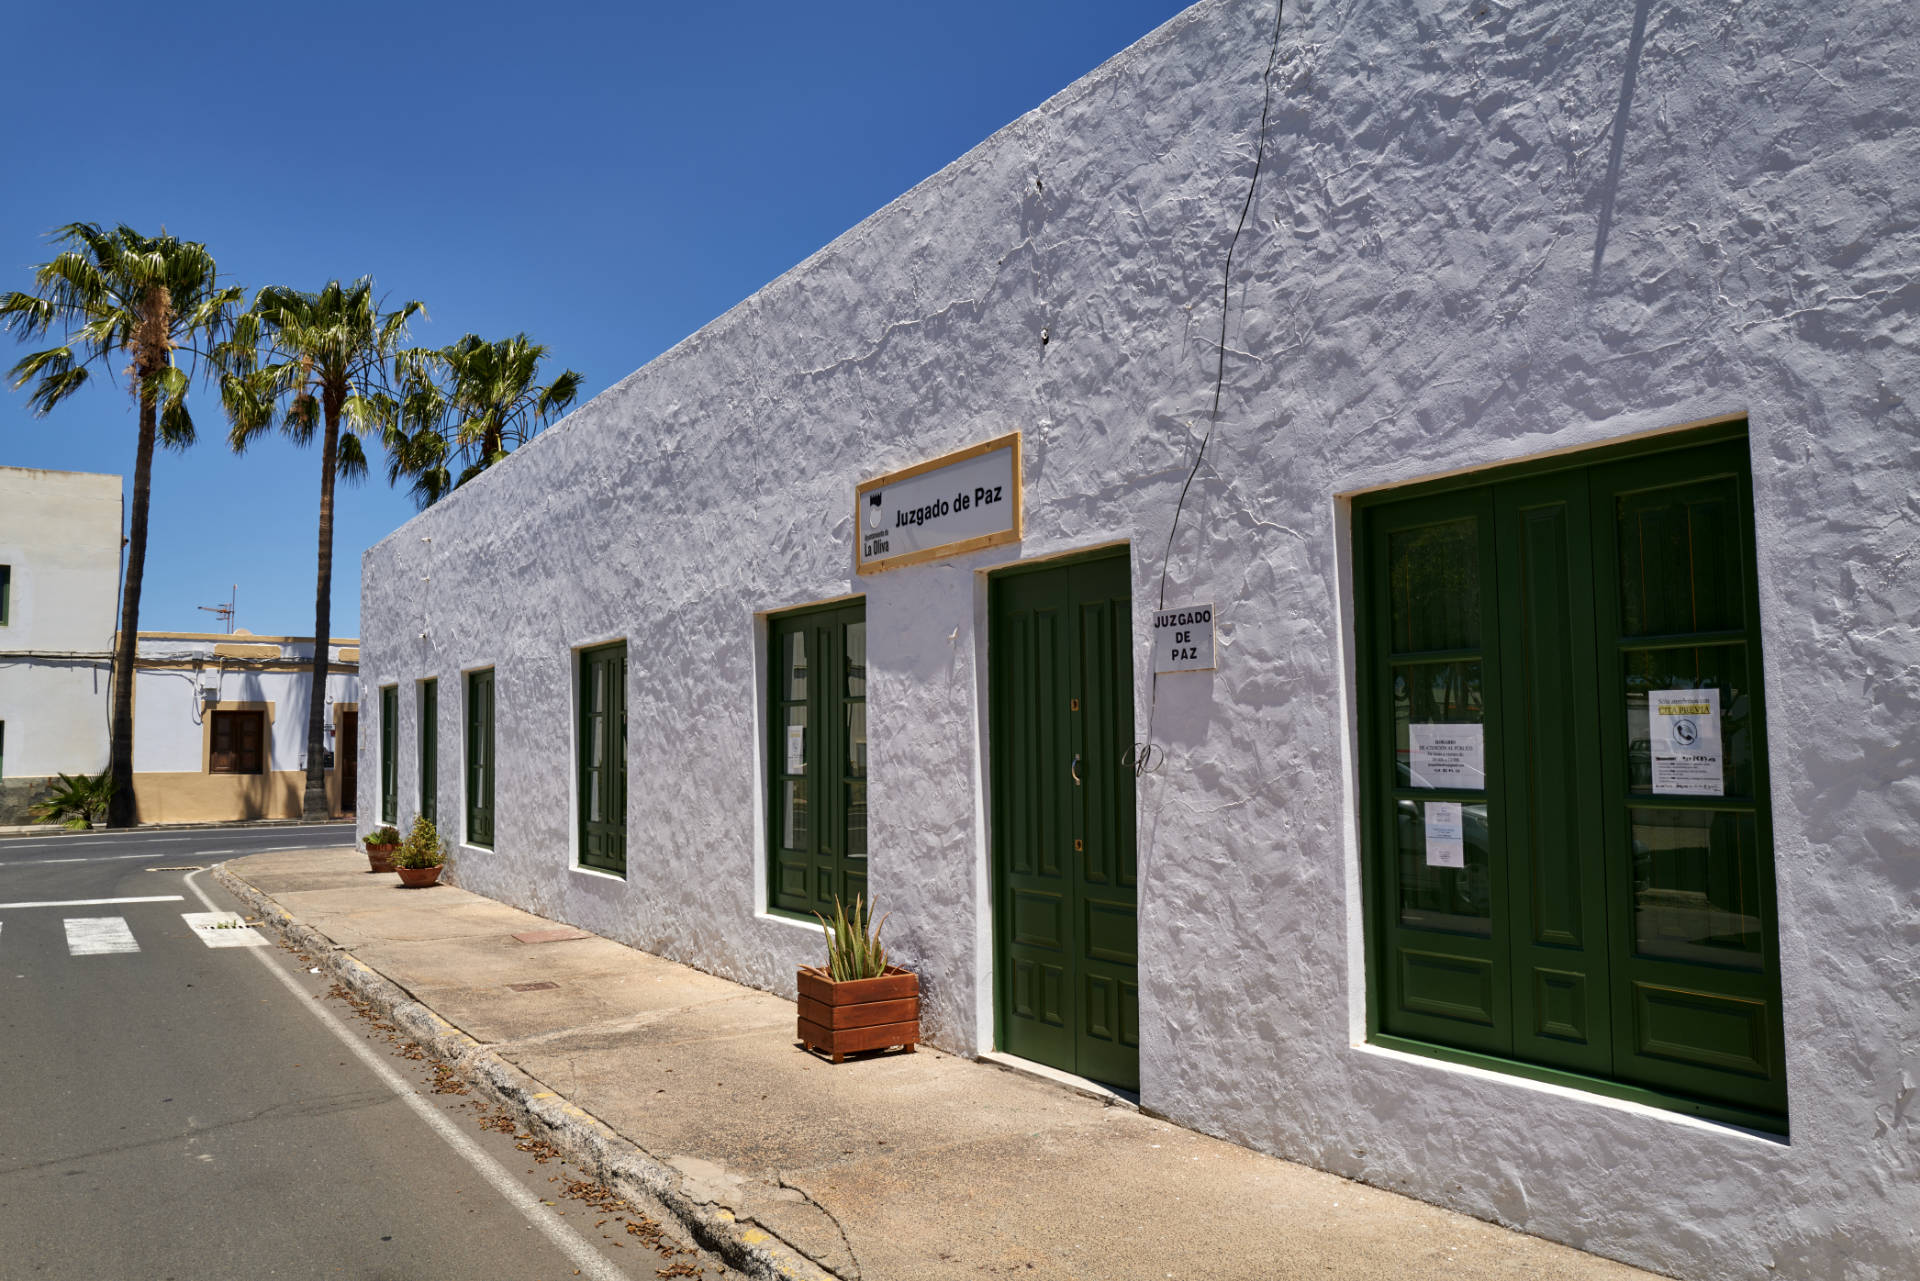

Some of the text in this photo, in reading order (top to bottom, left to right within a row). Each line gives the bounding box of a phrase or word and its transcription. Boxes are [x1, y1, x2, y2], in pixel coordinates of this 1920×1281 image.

[896, 486, 1003, 528] Juzgado de Paz
[864, 539, 889, 557] La Oliva
[1154, 610, 1211, 628] JUZGADO
[1175, 631, 1191, 643] DE
[1171, 647, 1197, 661] PAZ
